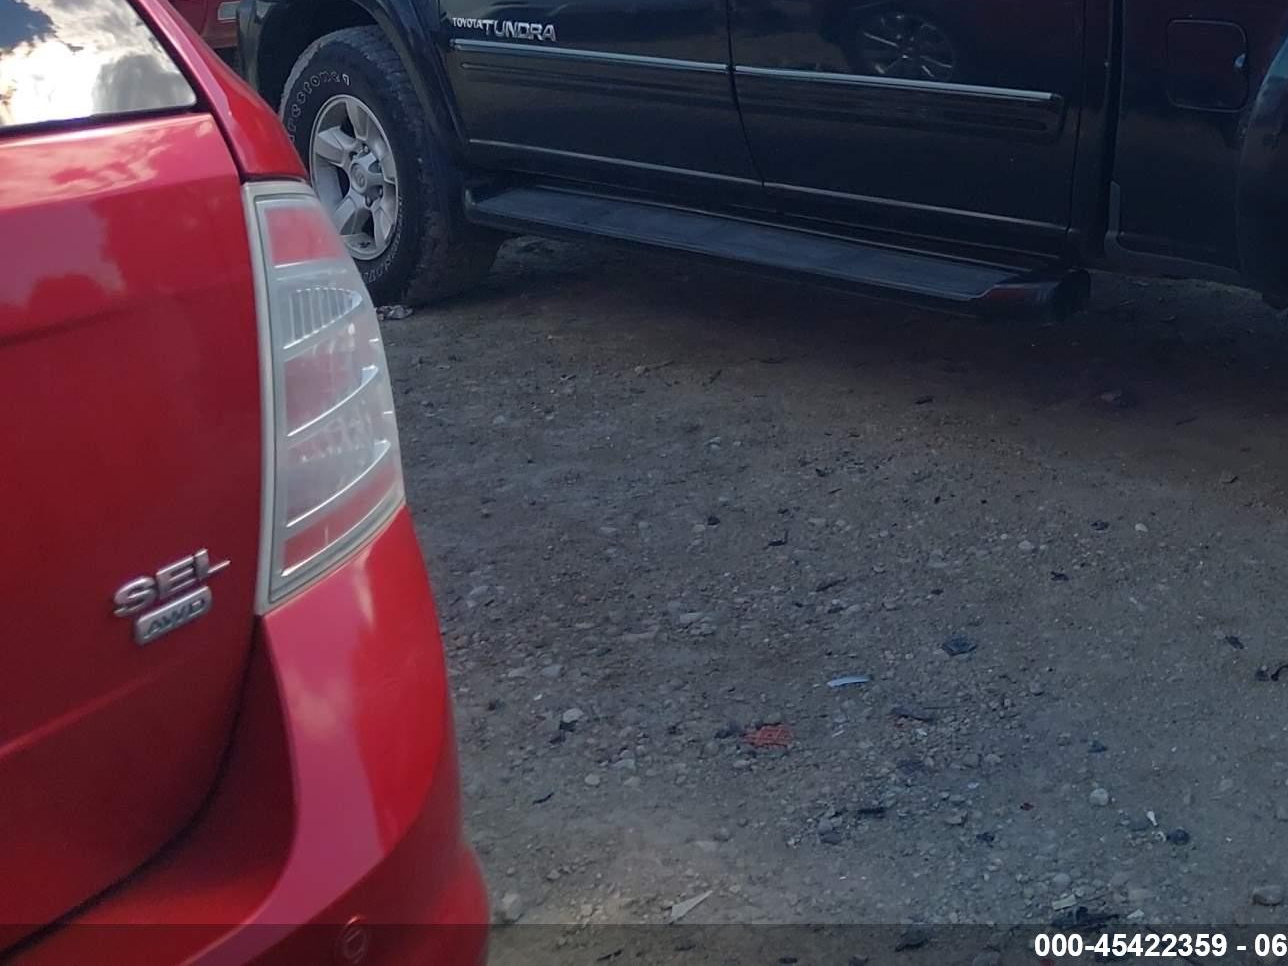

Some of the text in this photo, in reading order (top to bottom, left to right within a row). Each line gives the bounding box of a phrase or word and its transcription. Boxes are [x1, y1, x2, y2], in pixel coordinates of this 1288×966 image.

[452, 17, 556, 42] TOYOTA TUNDRA
[113, 548, 231, 617] SEL
[147, 597, 206, 636] AWD
